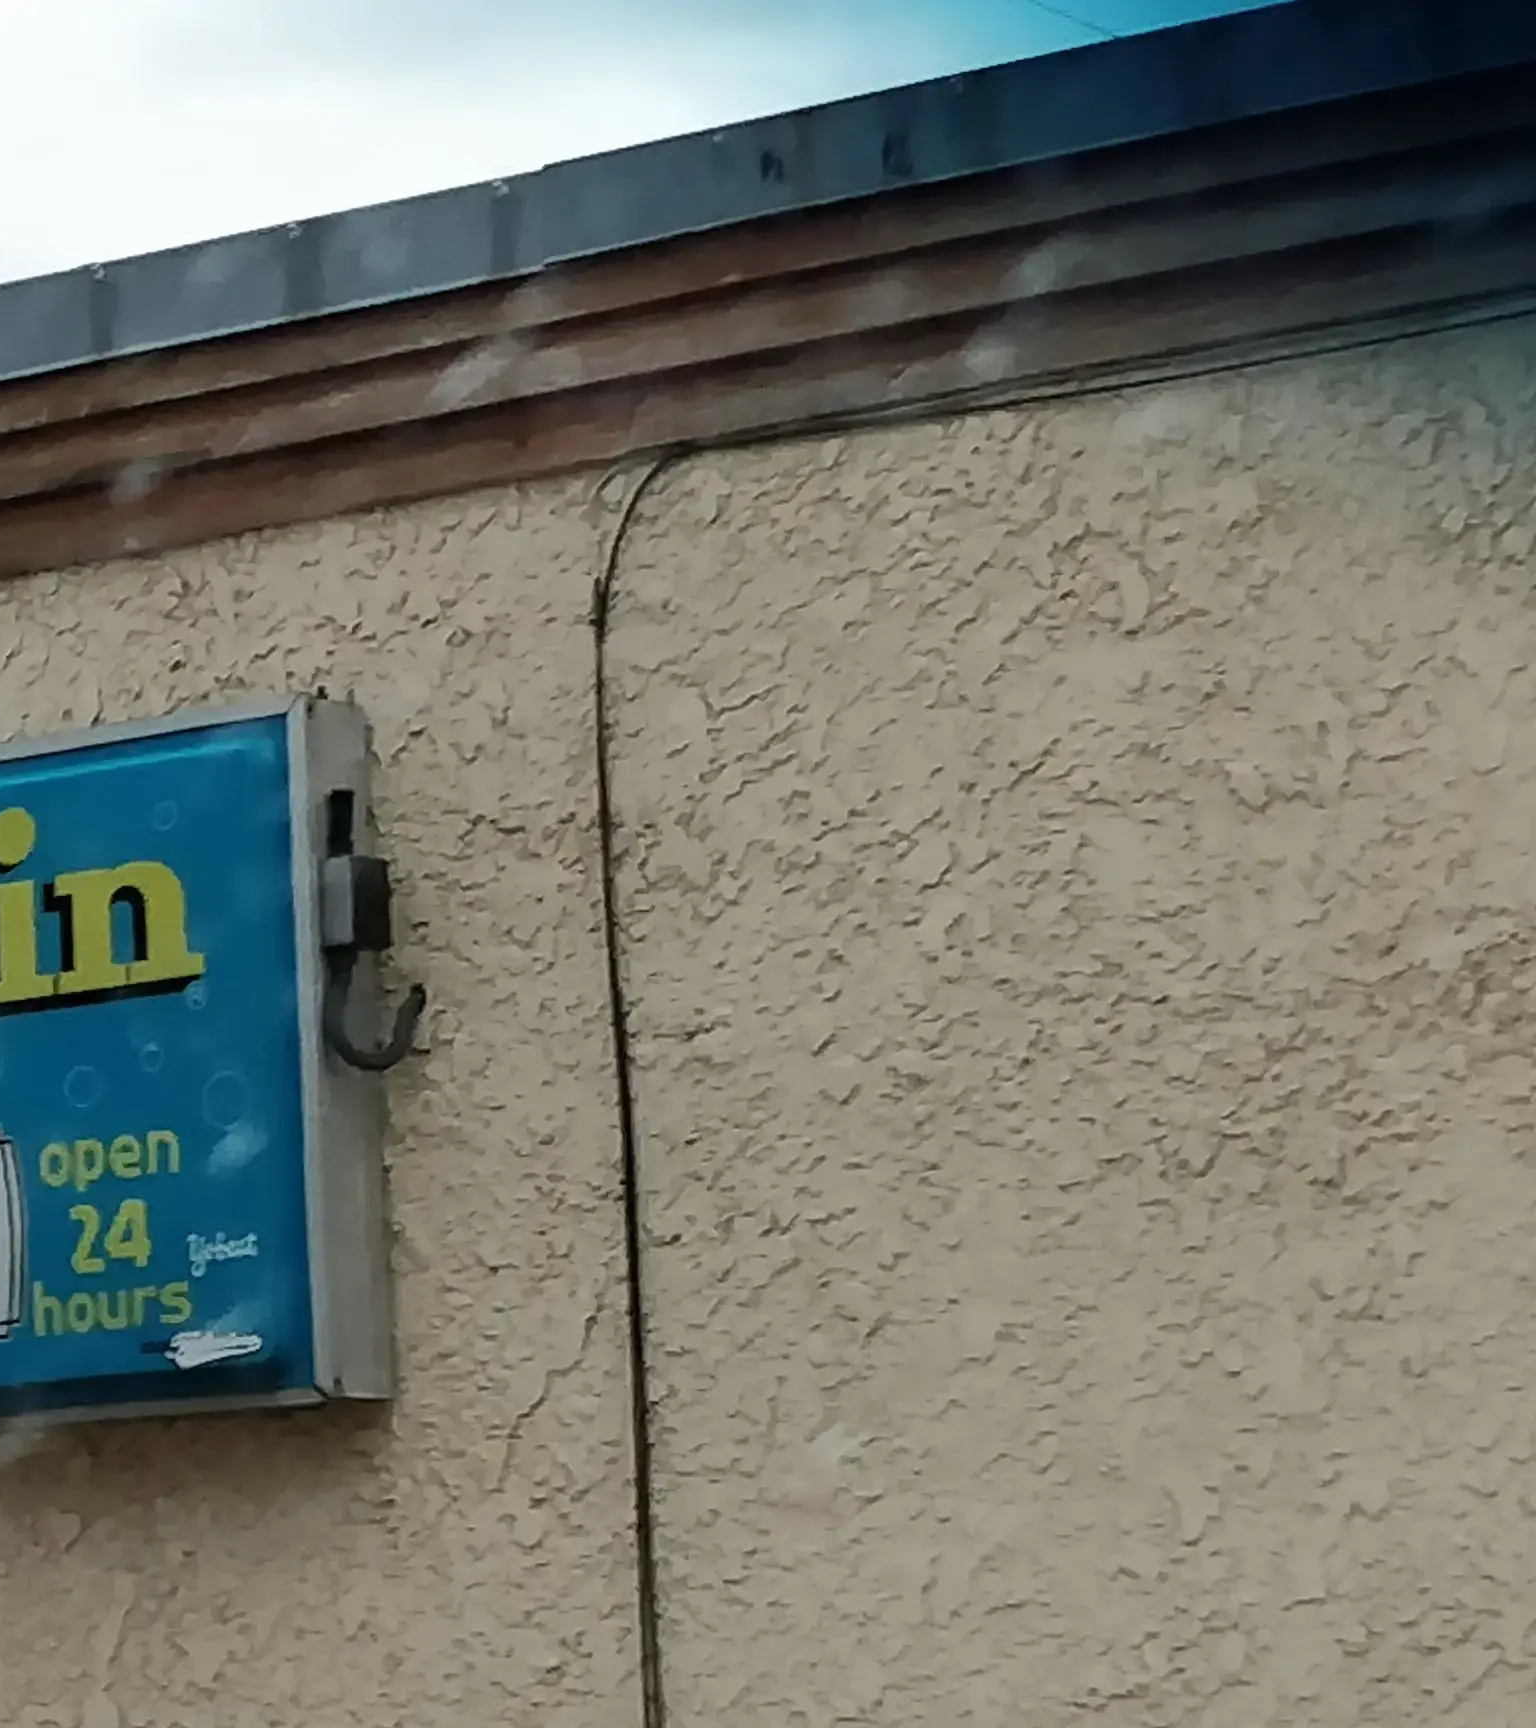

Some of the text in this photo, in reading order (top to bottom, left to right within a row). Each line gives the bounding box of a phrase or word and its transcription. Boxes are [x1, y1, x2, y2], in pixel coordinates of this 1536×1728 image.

[39, 1129, 181, 1192] open
[68, 1198, 152, 1274] 24
[32, 1280, 193, 1337] hours
